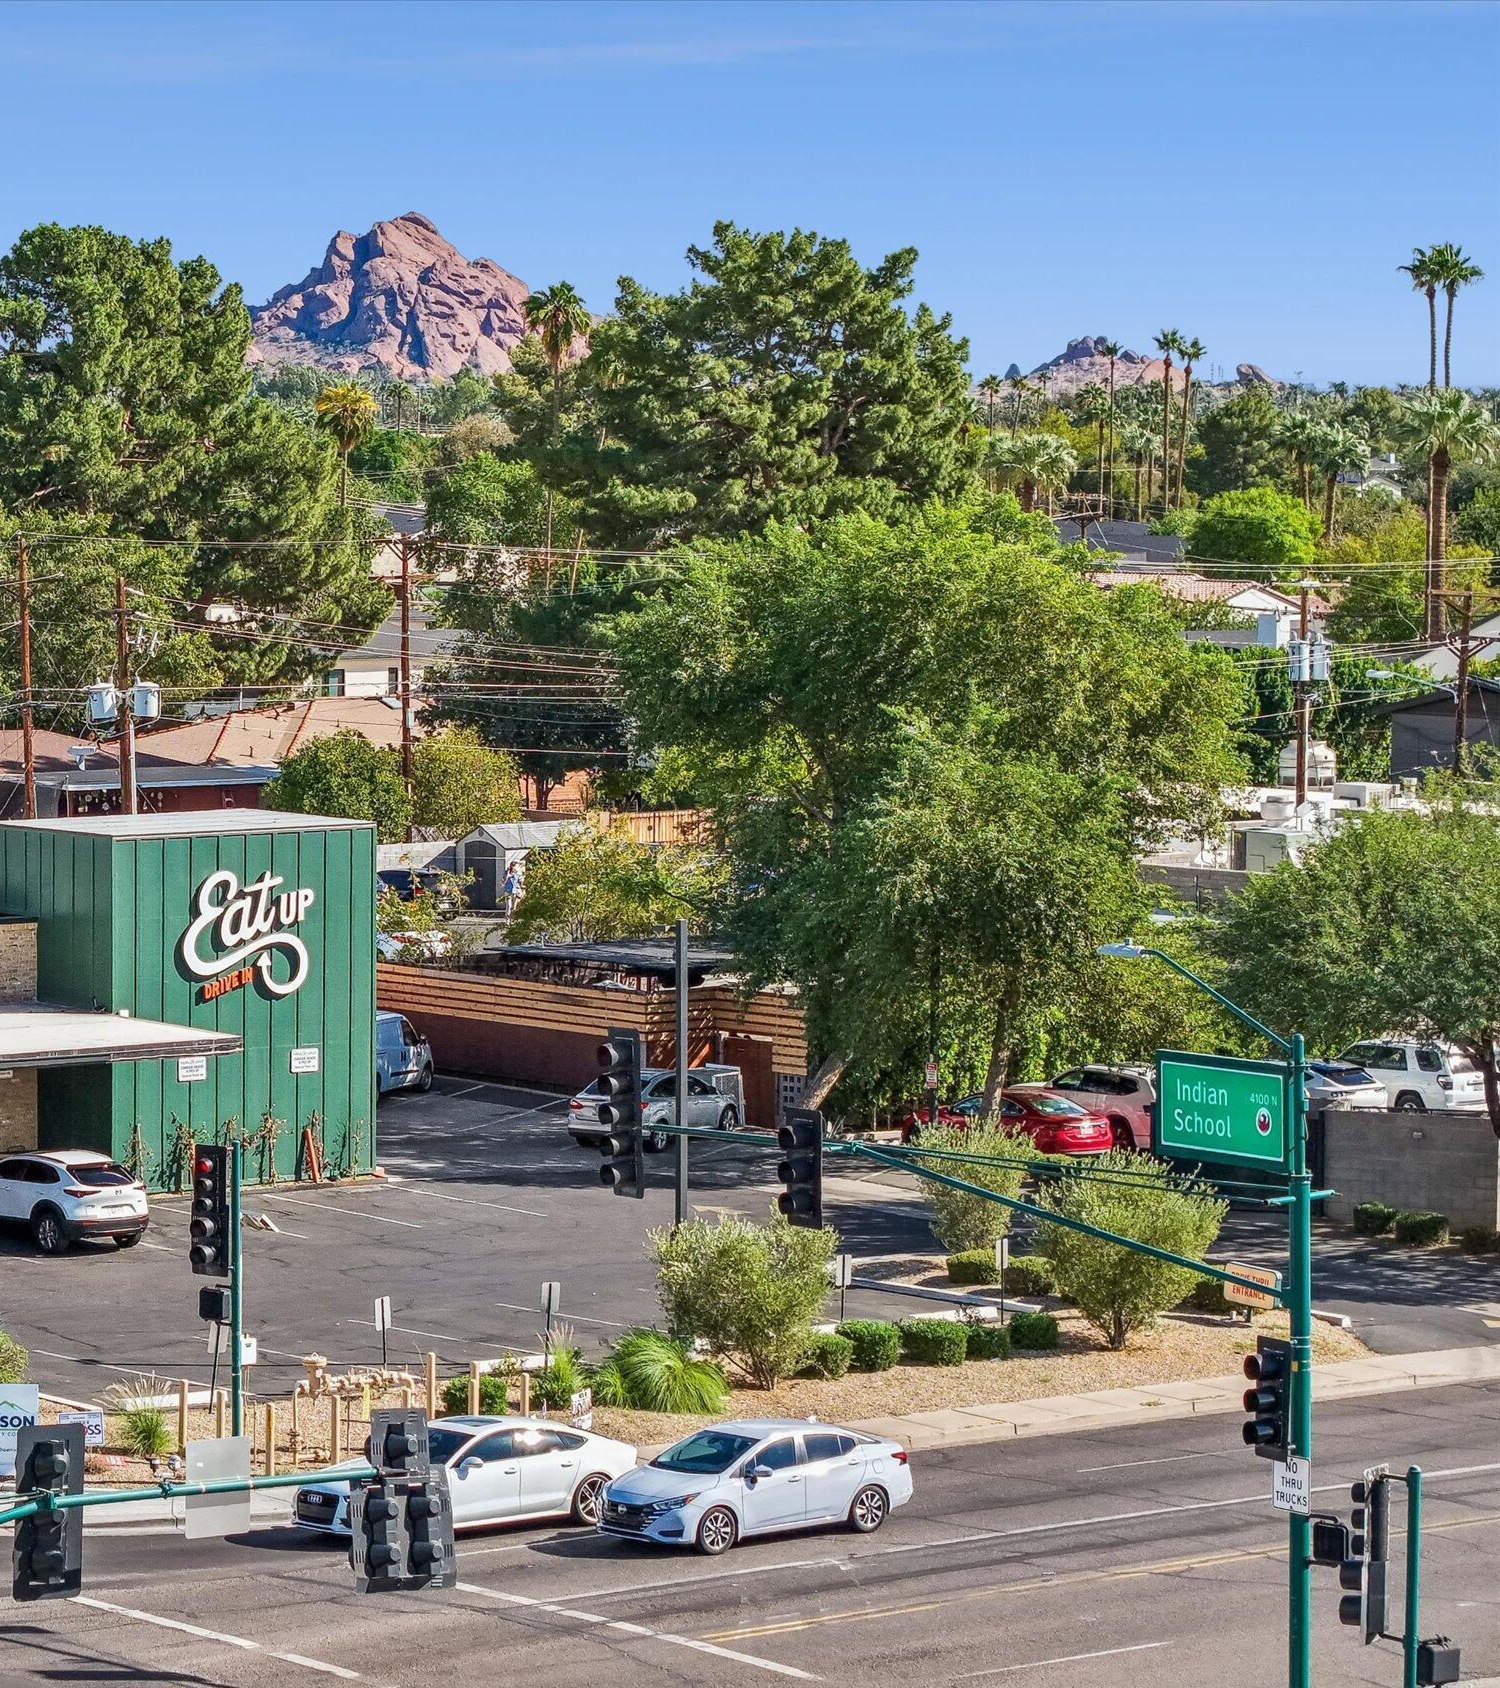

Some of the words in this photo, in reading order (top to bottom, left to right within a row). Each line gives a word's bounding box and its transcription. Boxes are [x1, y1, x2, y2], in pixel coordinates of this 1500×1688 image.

[183, 871, 283, 976] Eat
[280, 889, 313, 924] UP
[204, 973, 239, 999] DRIVE
[241, 967, 253, 984] IN
[1177, 1078, 1228, 1106] Indian
[1249, 1093, 1270, 1105] 4100
[1271, 1096, 1278, 1106] N
[1174, 1108, 1232, 1138] School
[1285, 1461, 1298, 1474] NO
[1281, 1476, 1302, 1490] THRU
[1275, 1490, 1308, 1507] TRUCKS
